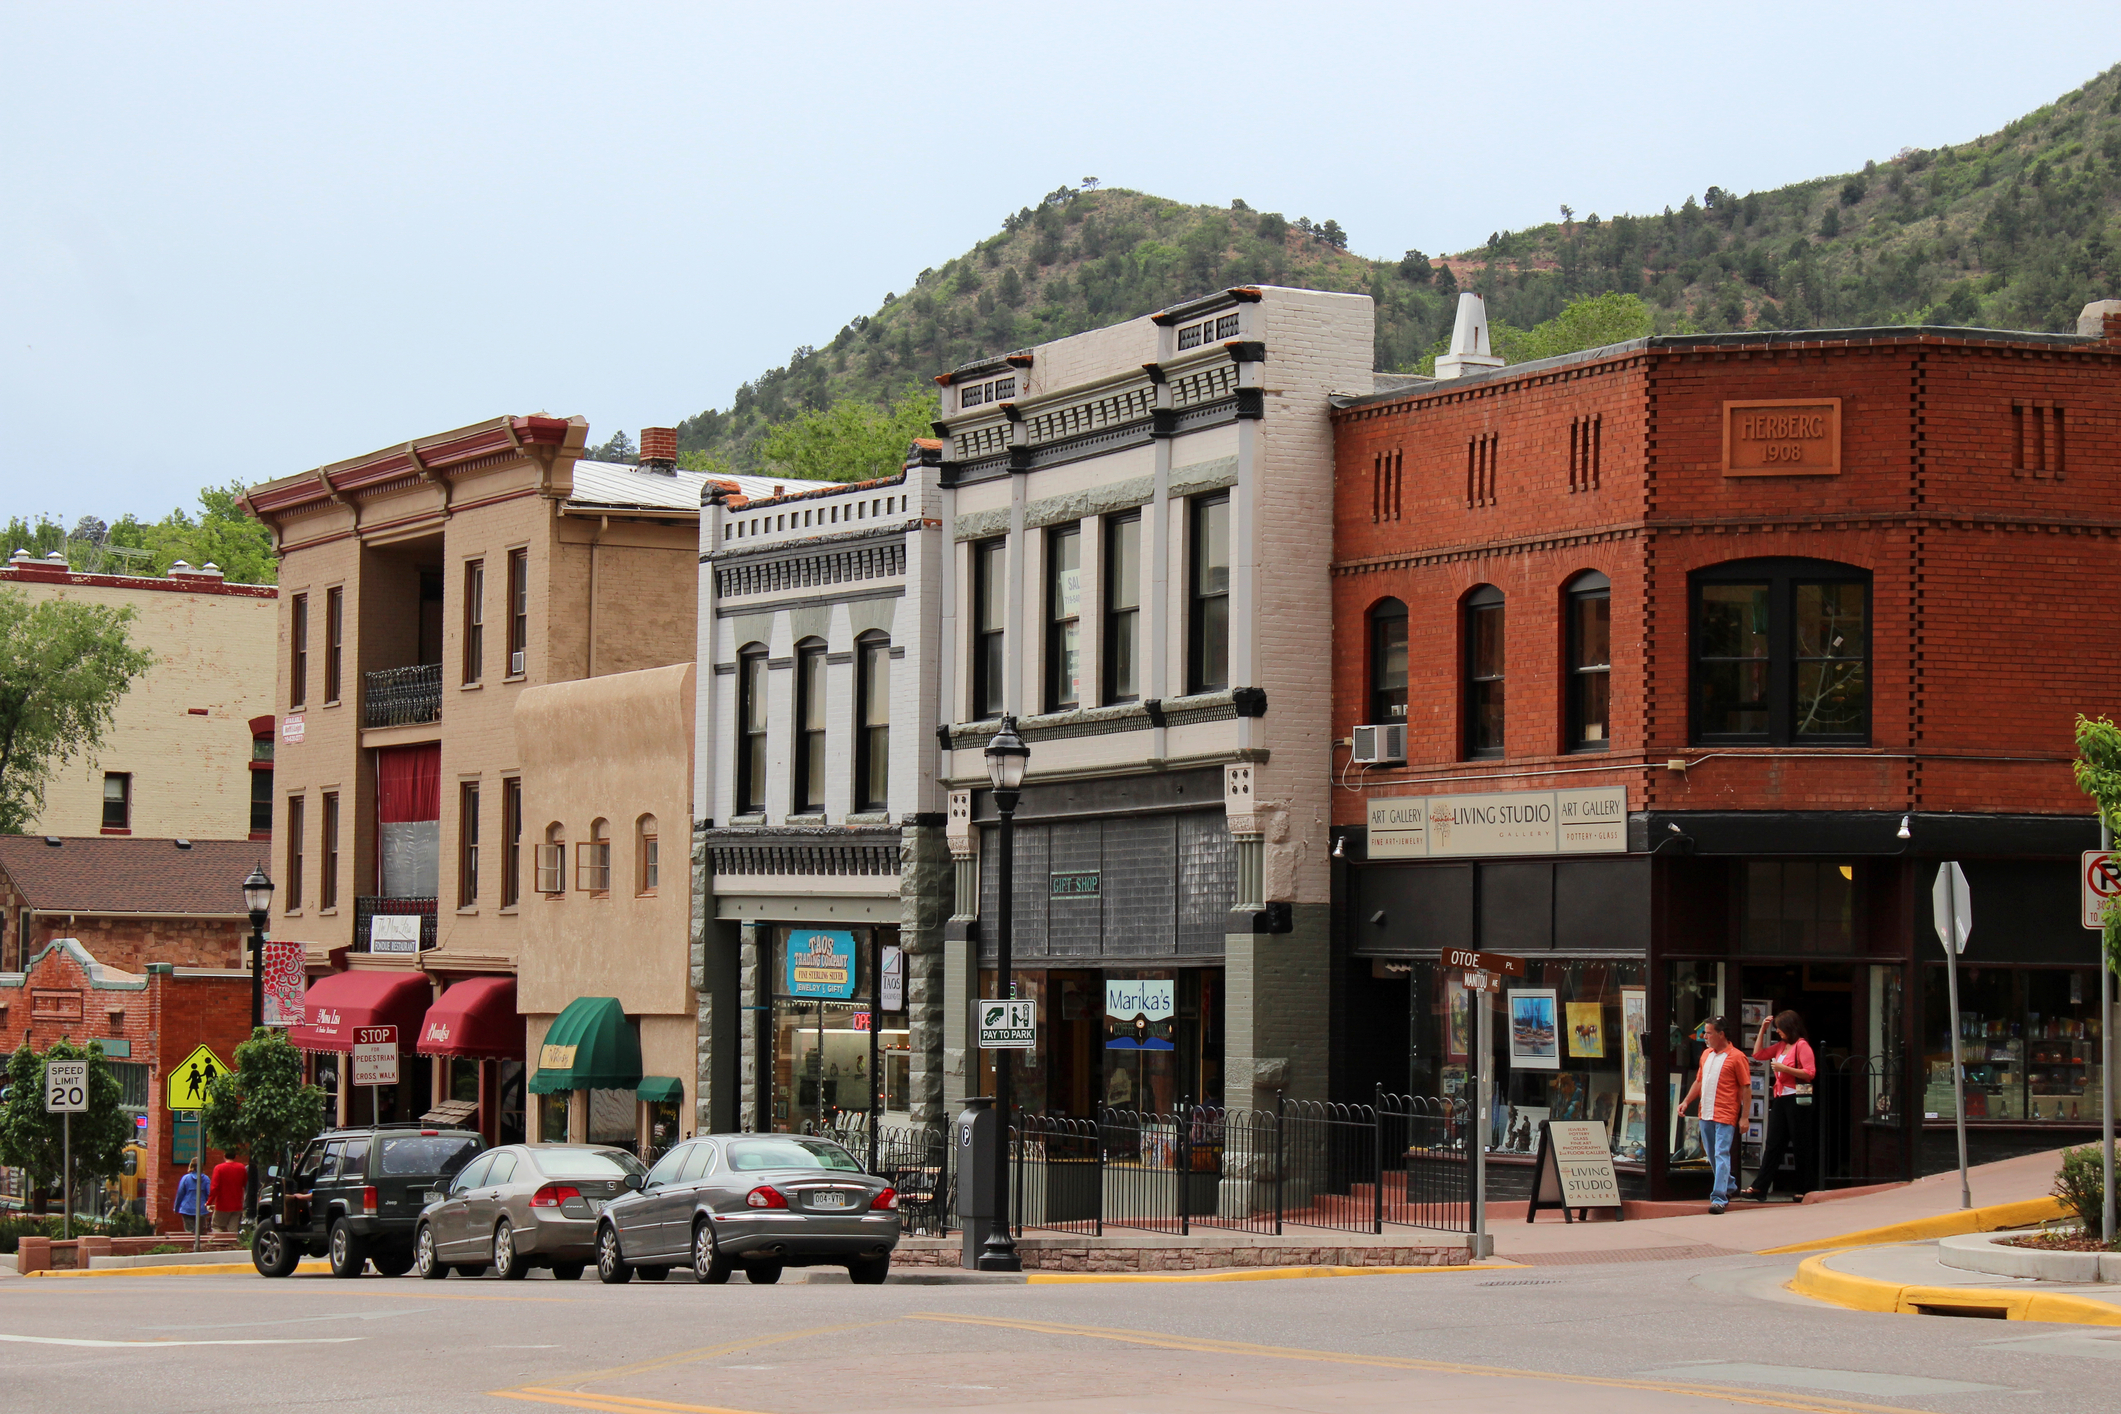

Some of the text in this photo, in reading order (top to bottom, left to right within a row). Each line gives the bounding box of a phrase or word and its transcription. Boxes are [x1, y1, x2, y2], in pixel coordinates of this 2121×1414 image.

[1741, 414, 1824, 440] HERBERG
[1761, 443, 1801, 462] 1908
[1068, 576, 1080, 590] SAL
[1453, 806, 1496, 825] LIVING
[1499, 804, 1550, 824] STUDIO
[1561, 800, 1621, 817] ART GALLERY
[1371, 808, 1422, 824] ART GALLERY
[1499, 830, 1550, 838] GALLERY
[1566, 831, 1618, 841] POTTERY GLASS
[1371, 838, 1383, 846] FINE
[1053, 876, 1098, 893] GIFT SHOP
[2090, 912, 2099, 922] TO
[375, 941, 416, 952] FONDUE RESTAURANT
[808, 935, 834, 957] TAOS
[794, 952, 848, 968] TRADING COMPANY
[1451, 950, 1515, 970] OTOE PL
[798, 970, 844, 981] FINE STERLING SILVER
[883, 975, 901, 990] TAOS
[1464, 972, 1488, 989] MANITOU
[796, 983, 821, 993] JEWELRY
[828, 985, 844, 994] GIFTS
[1110, 981, 1171, 1010] Marika's
[854, 1014, 872, 1031] OPE
[1113, 1022, 1170, 1037] COFFEE HOUSE
[360, 1029, 390, 1043] STOP
[983, 1030, 1033, 1040] PAY TO PARK
[356, 1055, 395, 1063] PEDESTRIAN
[51, 1067, 84, 1075] SPEED
[356, 1073, 377, 1081] CROSS
[55, 1077, 80, 1085] LIMIT
[51, 1087, 84, 1106] 20
[1571, 1166, 1610, 1177] LIVING
[1568, 1180, 1613, 1191] STUDIO
